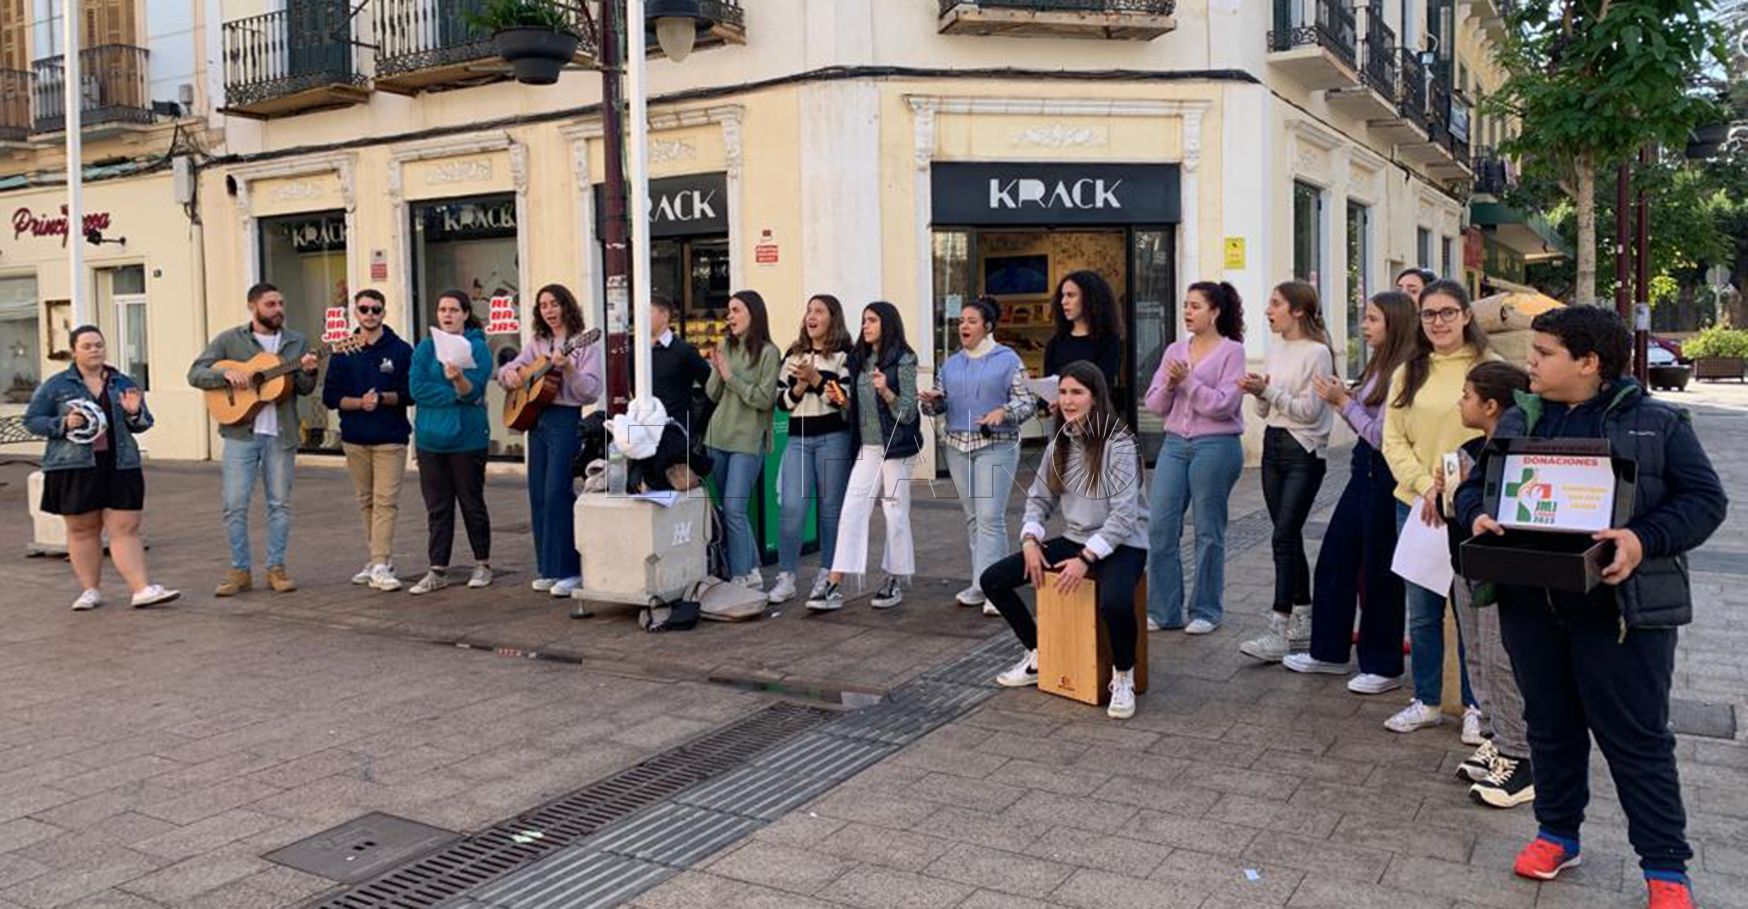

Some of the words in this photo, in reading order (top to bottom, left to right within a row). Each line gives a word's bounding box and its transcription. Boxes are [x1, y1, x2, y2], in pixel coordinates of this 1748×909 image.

[648, 190, 717, 222] ACK
[989, 178, 1122, 209] KRACK
[443, 204, 517, 232] KRACK
[1523, 456, 1598, 466] DONACIONES
